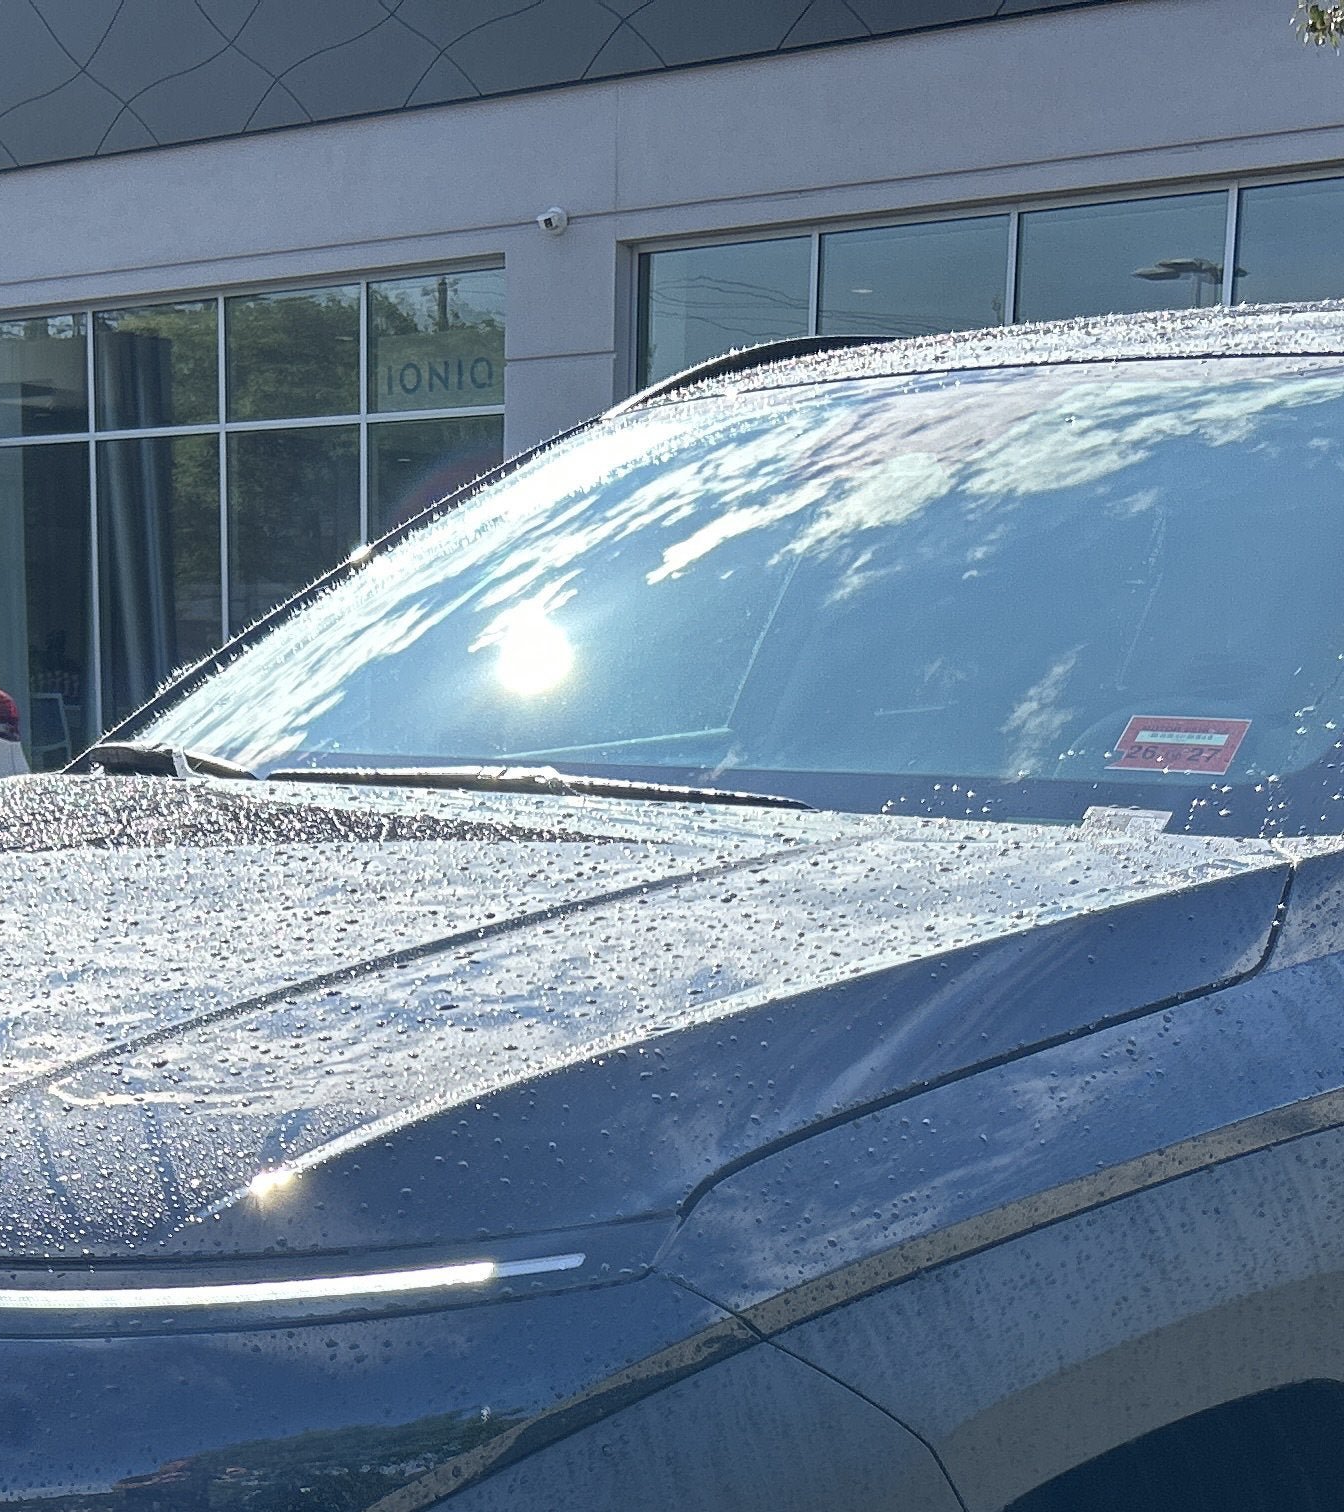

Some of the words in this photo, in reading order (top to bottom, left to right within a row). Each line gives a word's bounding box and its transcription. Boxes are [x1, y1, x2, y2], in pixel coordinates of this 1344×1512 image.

[386, 356, 494, 396] IONIQ
[1124, 744, 1159, 760] 26
[1186, 747, 1223, 762] 27
